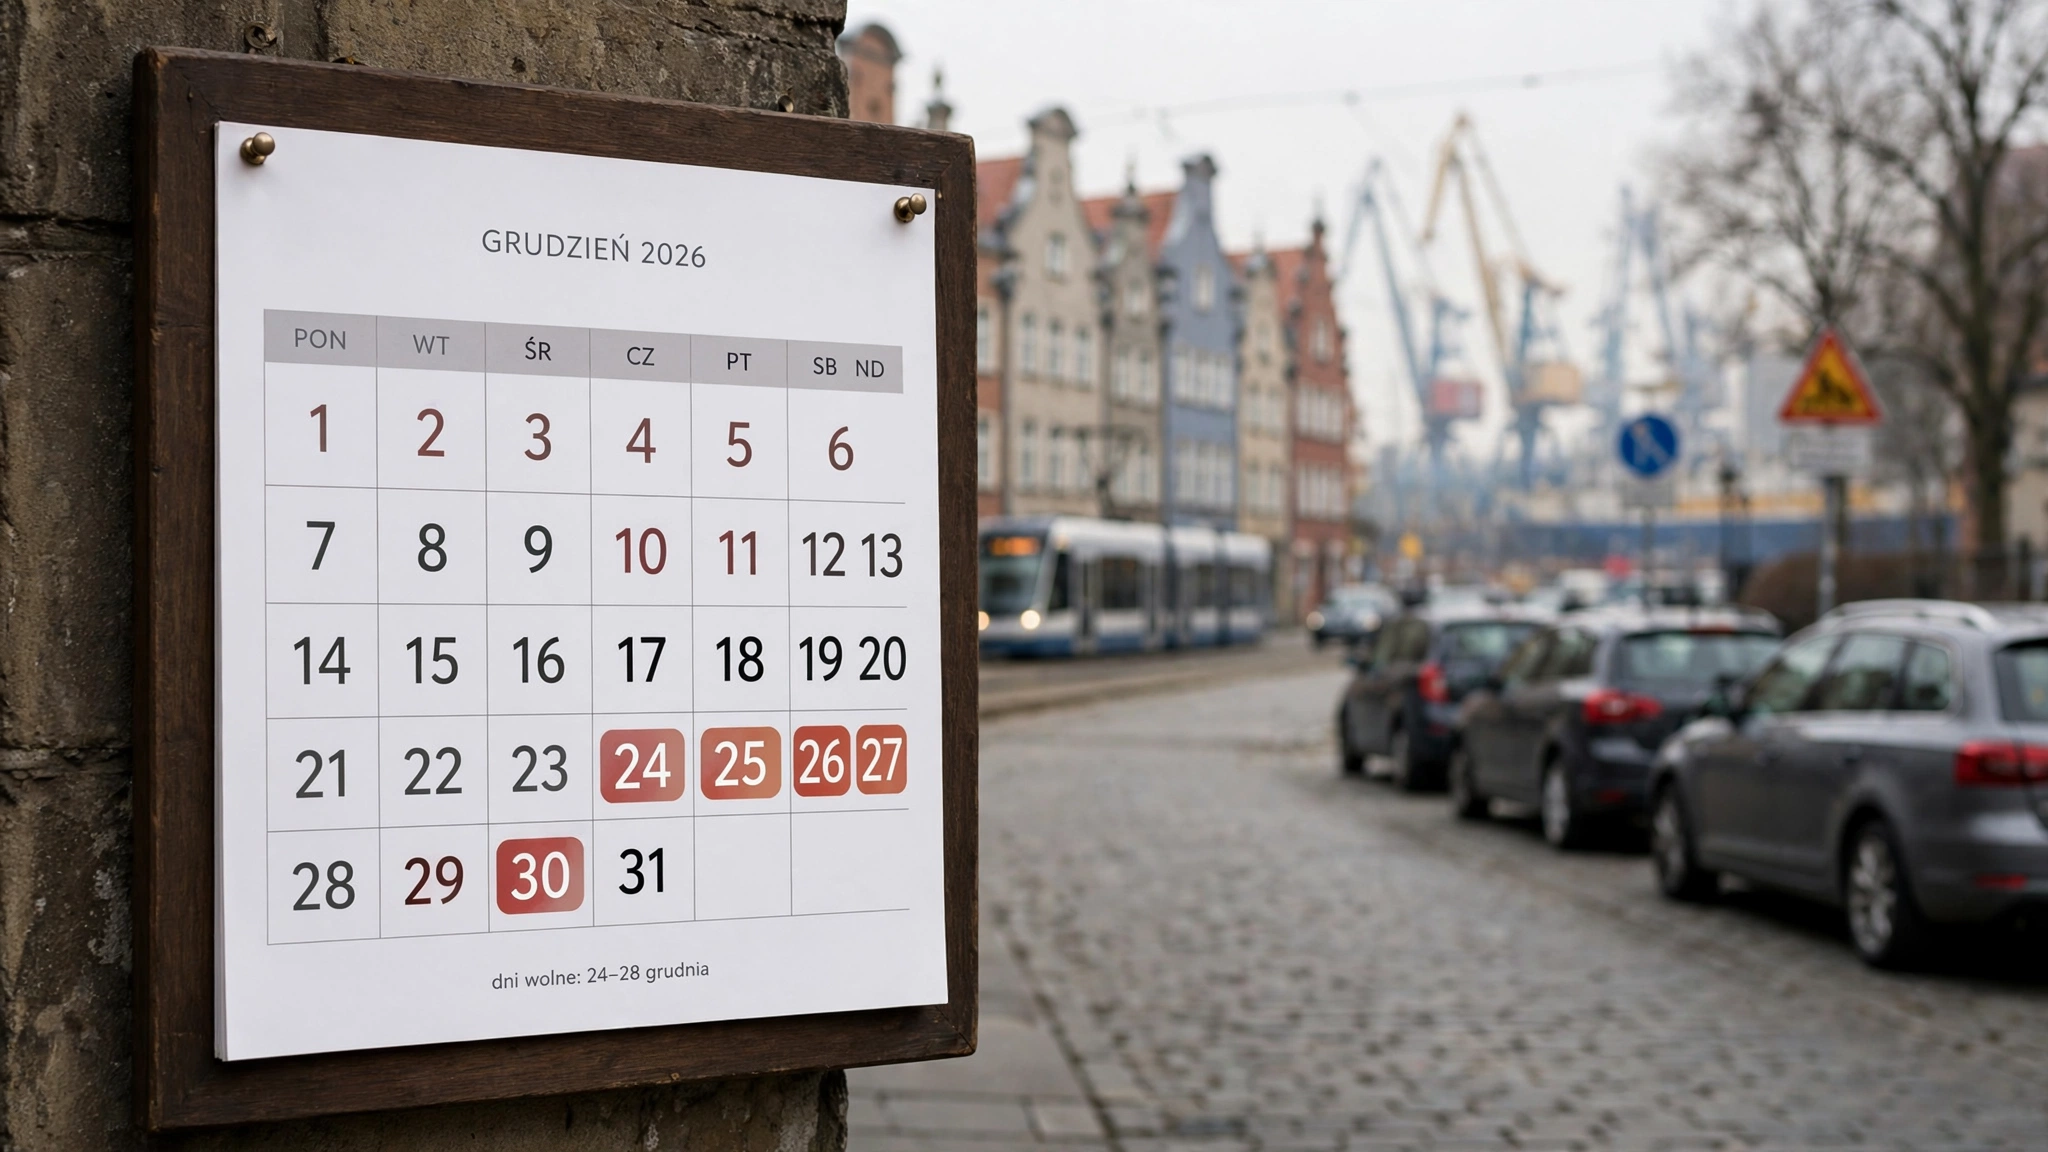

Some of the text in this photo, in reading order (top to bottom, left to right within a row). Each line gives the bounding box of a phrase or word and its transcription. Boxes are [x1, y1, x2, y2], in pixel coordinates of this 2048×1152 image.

[482, 229, 706, 269] GRUDZIEŃ 2026
[294, 327, 885, 378] PON WT ŚR CZ PT SB ND
[309, 403, 854, 471] 1 2 3 4 5 6
[306, 520, 903, 579] 7 8 9 10 11 12 13
[293, 635, 907, 685] 14 15 16 17 18 19 20
[295, 737, 903, 799] 21 22 23 24 25 26 27
[292, 847, 664, 912] 28 29 30 31
[491, 972, 519, 990] dni
[524, 969, 581, 988] wolne:
[645, 961, 709, 984] grudnia
